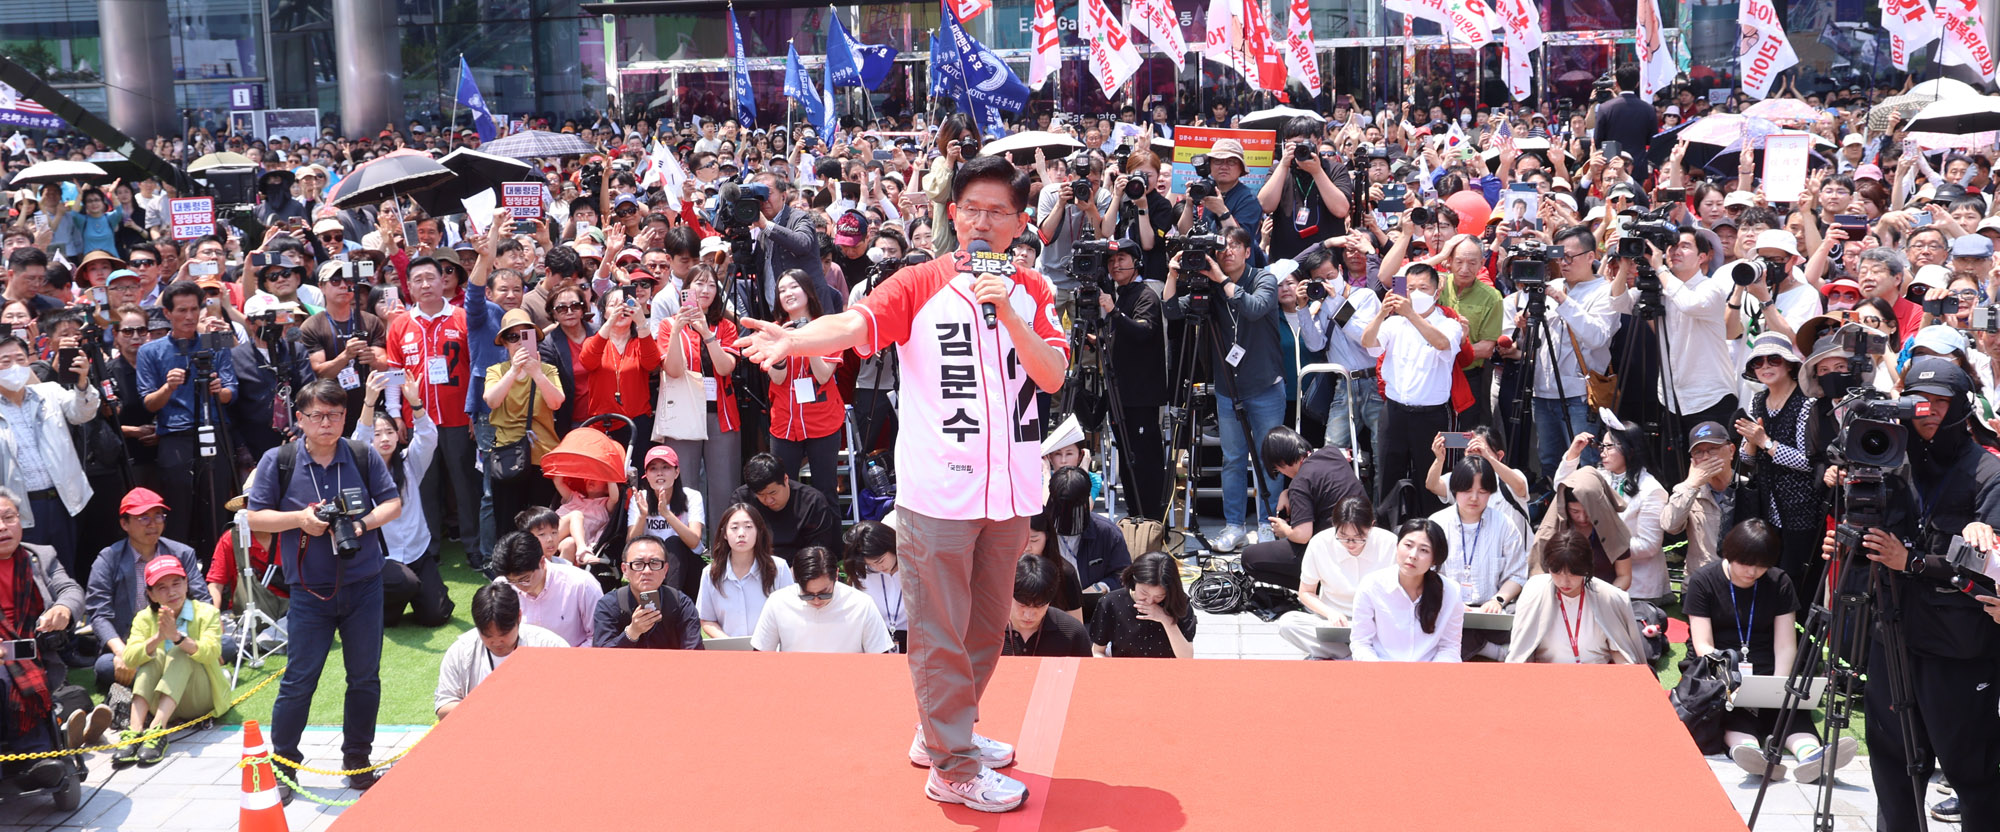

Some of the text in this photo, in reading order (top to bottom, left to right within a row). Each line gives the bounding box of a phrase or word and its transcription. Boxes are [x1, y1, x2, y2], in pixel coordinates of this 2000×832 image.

[1179, 11, 1193, 27] 동
[950, 23, 971, 54] 대한민국
[968, 53, 982, 71] 수호
[1067, 112, 1085, 123] Eas
[506, 186, 539, 195] 대통령은
[174, 201, 210, 212] 대통령은
[505, 196, 540, 206] 정정당당
[514, 208, 539, 216] 김문수
[174, 212, 212, 224] 정정당당
[176, 226, 212, 236] 2 김문수
[954, 250, 972, 271] 2
[972, 258, 1017, 275] 김문수
[935, 323, 980, 443] 김문수
[949, 464, 972, 472] 국민의힘
